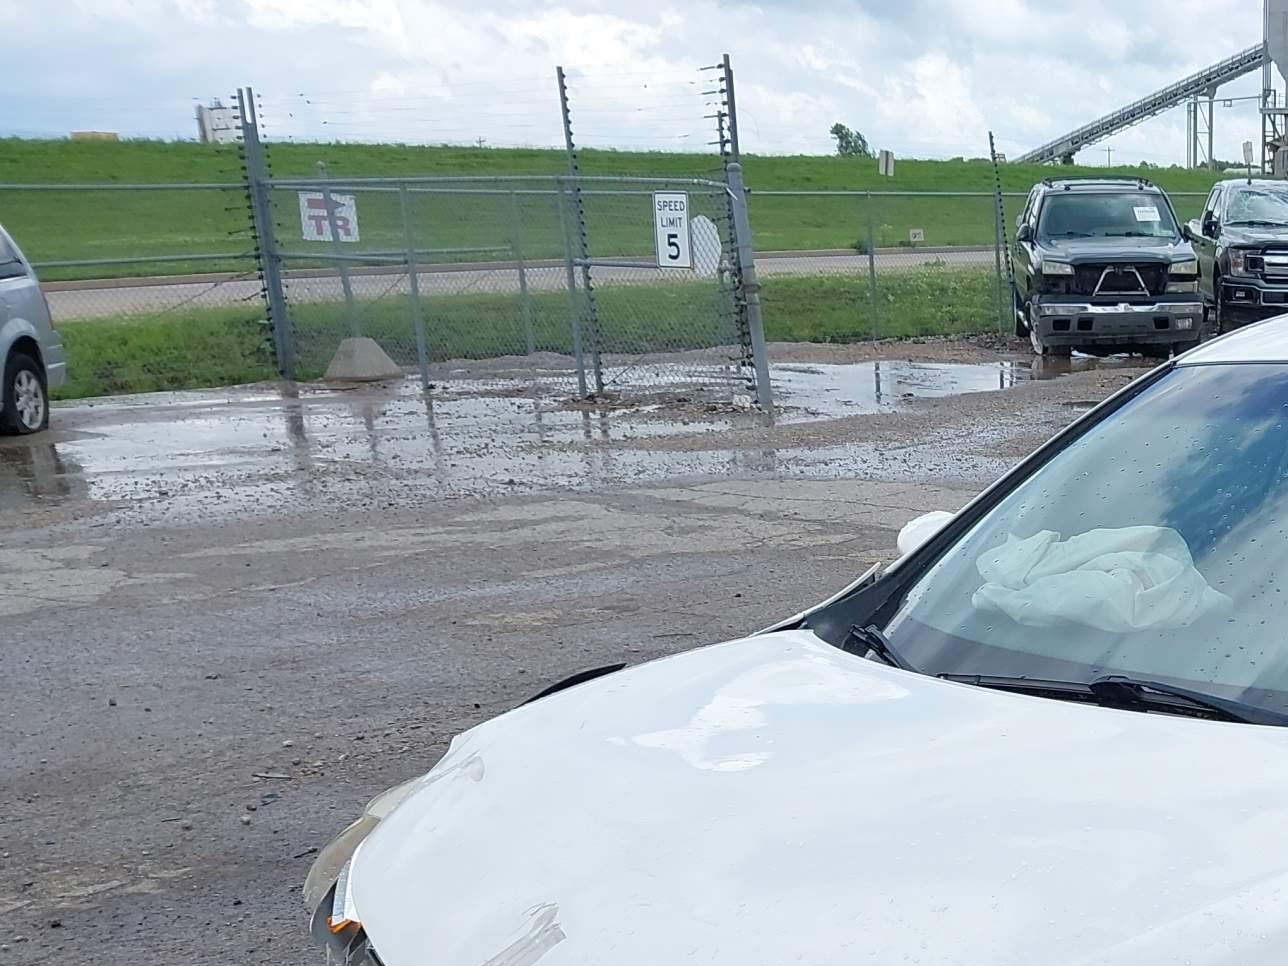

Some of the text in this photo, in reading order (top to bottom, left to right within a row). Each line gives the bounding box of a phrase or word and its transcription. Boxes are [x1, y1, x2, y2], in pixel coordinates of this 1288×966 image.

[657, 200, 685, 211] SPEED
[660, 216, 683, 228] LIMIT
[667, 233, 680, 260] 5
